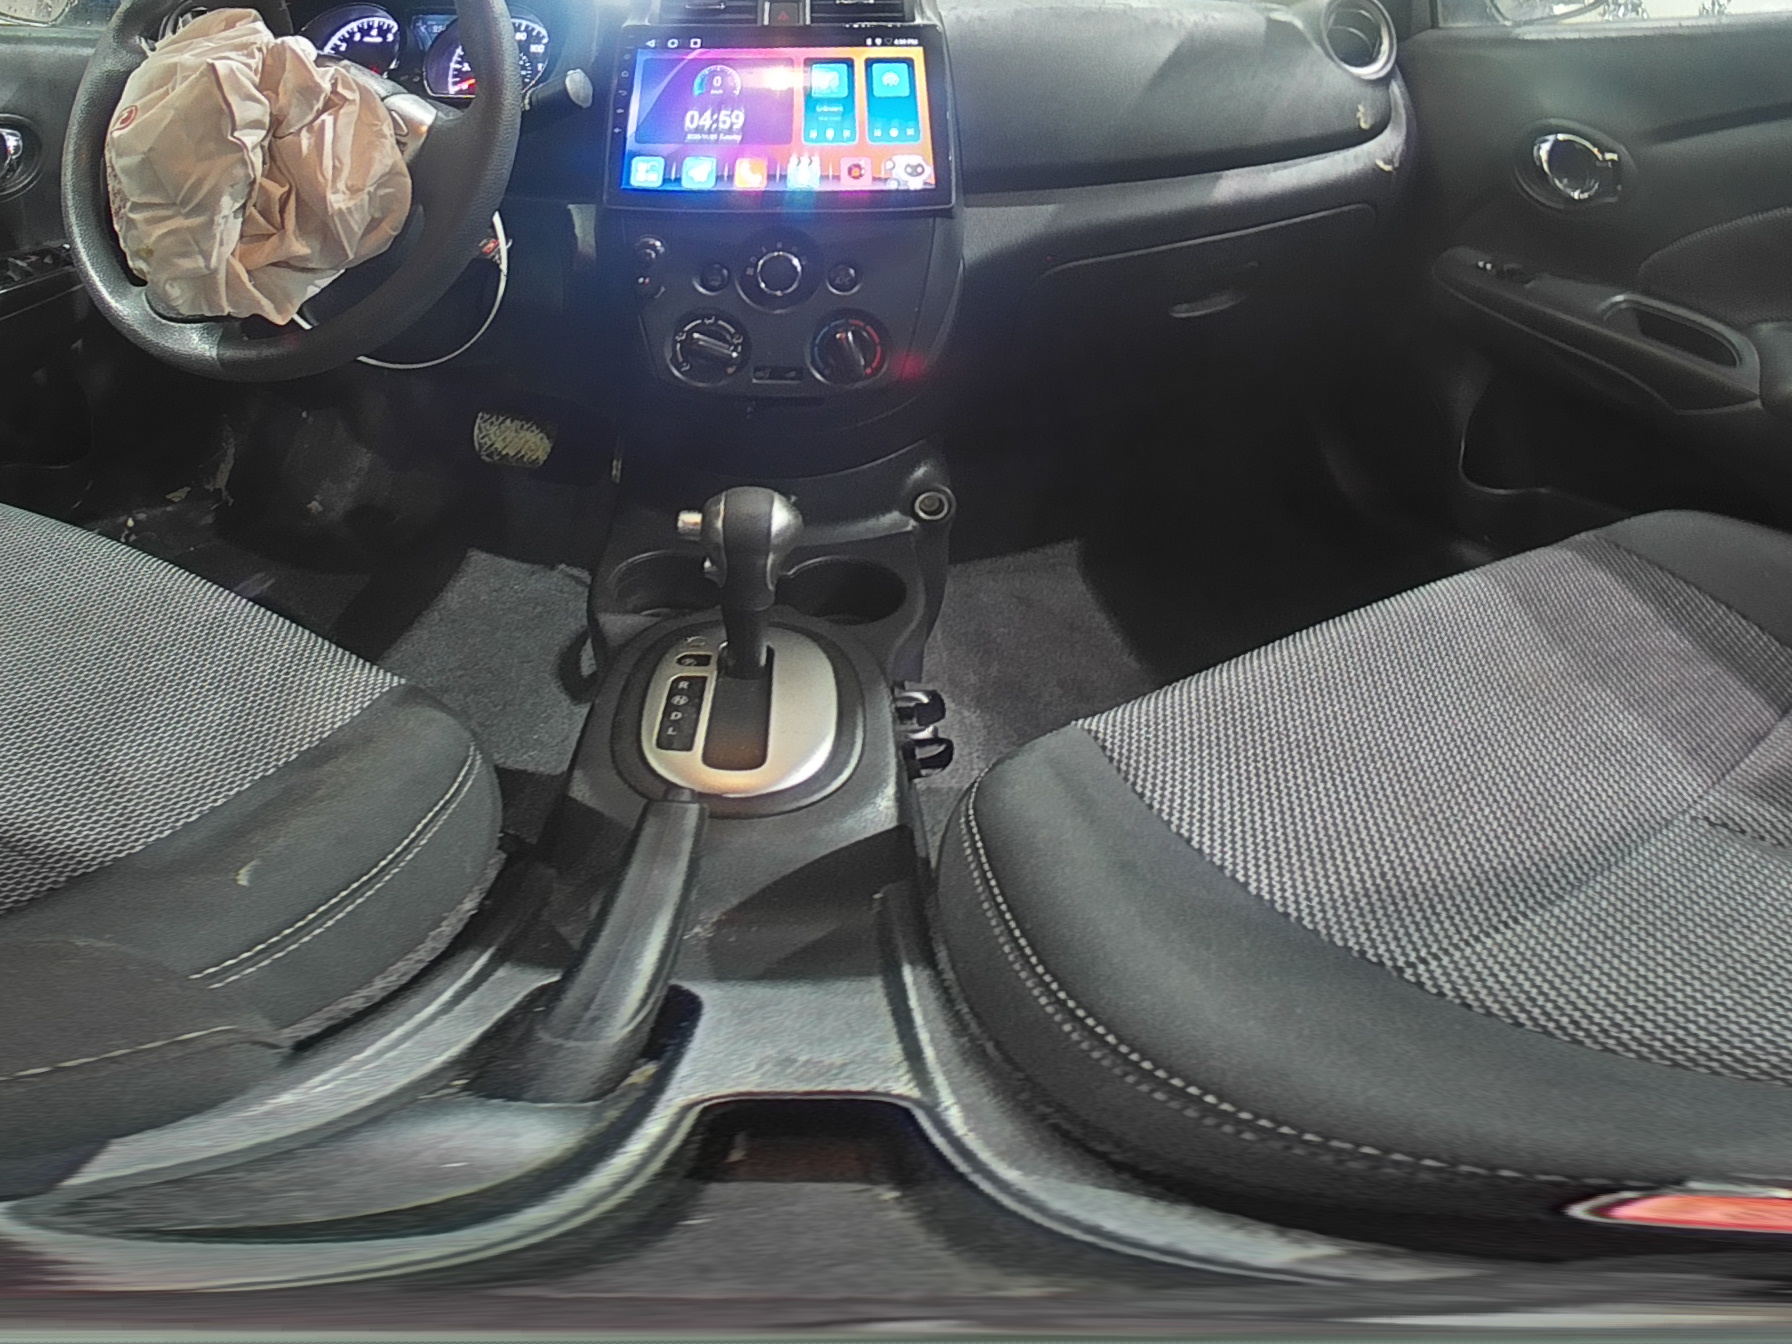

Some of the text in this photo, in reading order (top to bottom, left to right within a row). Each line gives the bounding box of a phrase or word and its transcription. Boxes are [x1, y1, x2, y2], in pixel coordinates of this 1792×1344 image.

[685, 109, 744, 131] 04:59
[678, 681, 690, 689] R
[670, 711, 683, 720] D
[667, 726, 678, 735] L
